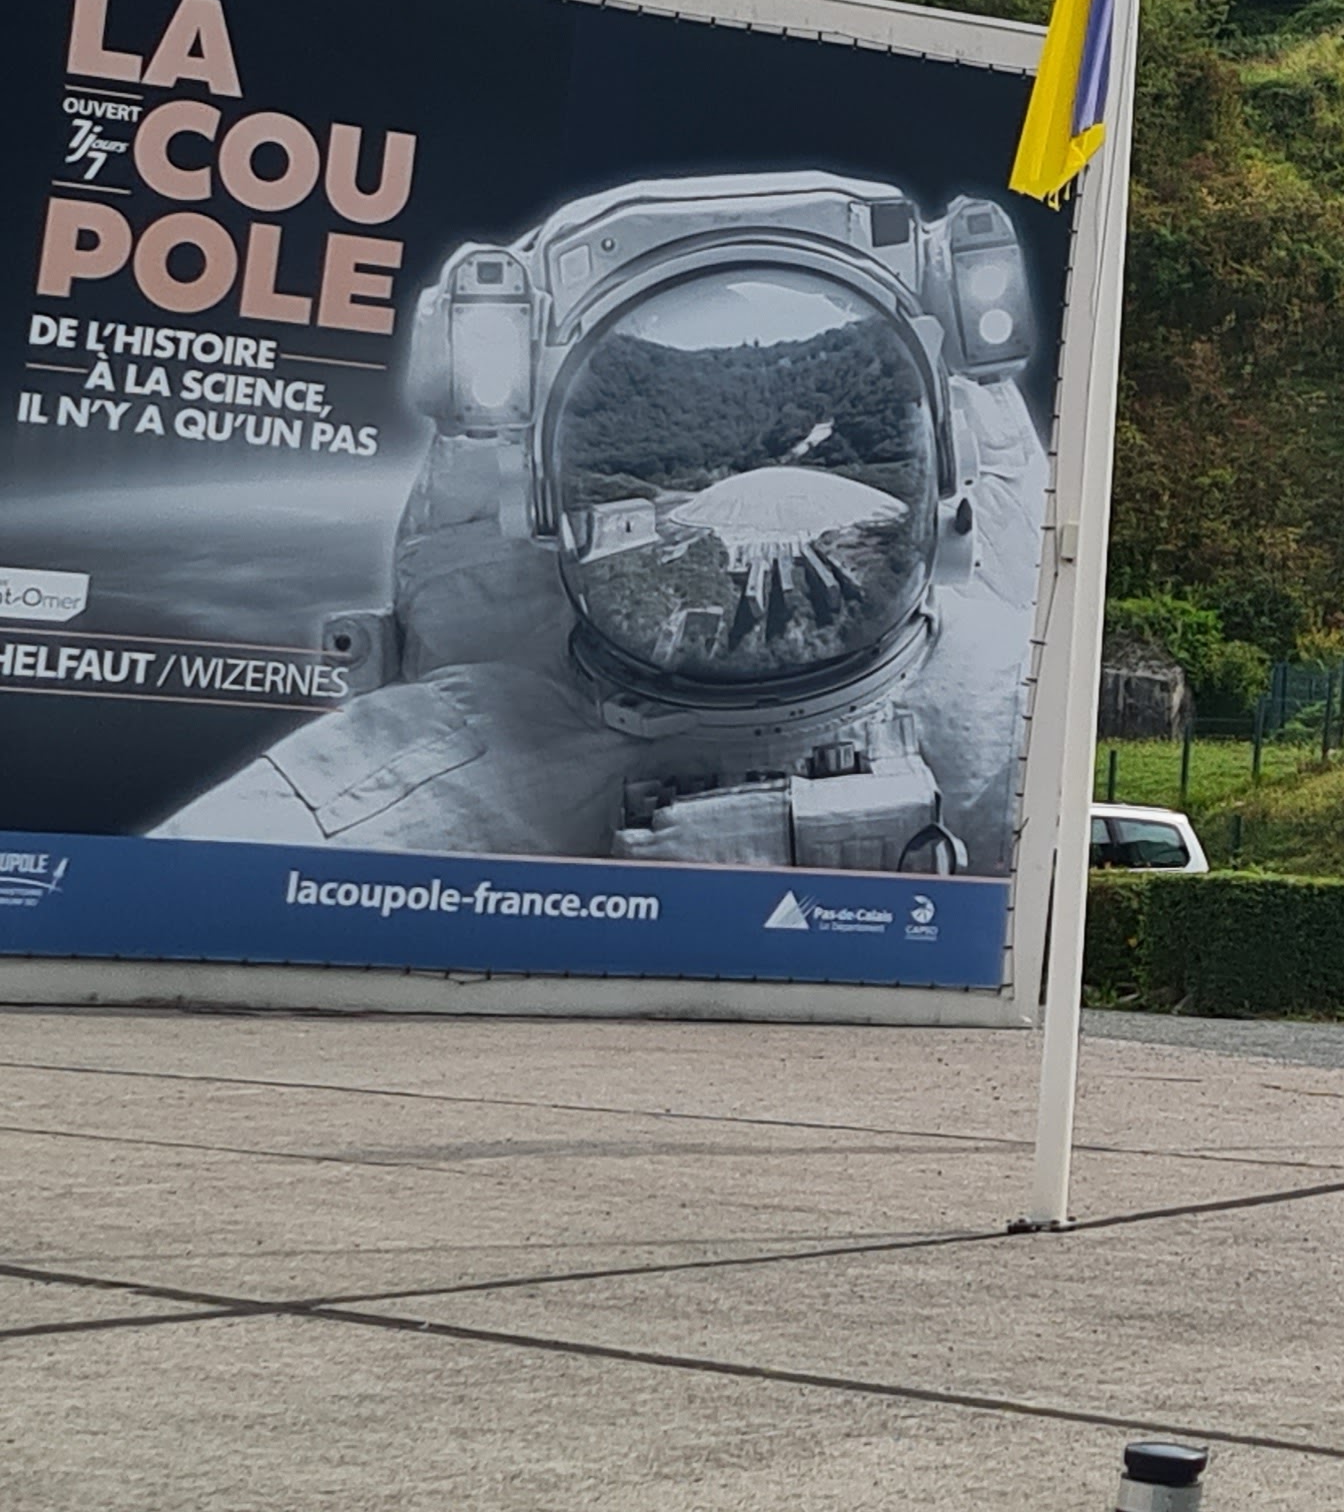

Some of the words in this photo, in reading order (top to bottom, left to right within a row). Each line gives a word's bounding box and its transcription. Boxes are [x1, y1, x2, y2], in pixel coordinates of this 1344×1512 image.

[62, 96, 143, 123] OUVERT
[83, 150, 108, 180] 7
[133, 99, 417, 225] COU
[36, 196, 404, 335] POLE
[29, 314, 78, 349] DE
[85, 323, 277, 370] L'HISTOIRE
[84, 351, 116, 392] À
[124, 363, 171, 397] LA
[180, 370, 333, 418] SCIENCE,
[17, 393, 48, 424] IL
[57, 395, 132, 431] N'Y
[134, 404, 165, 436] A
[174, 408, 302, 449] QU'UN
[311, 421, 378, 457] PAS
[181, 654, 349, 698] WIZERNES
[286, 870, 659, 919] lacoupole-france.com
